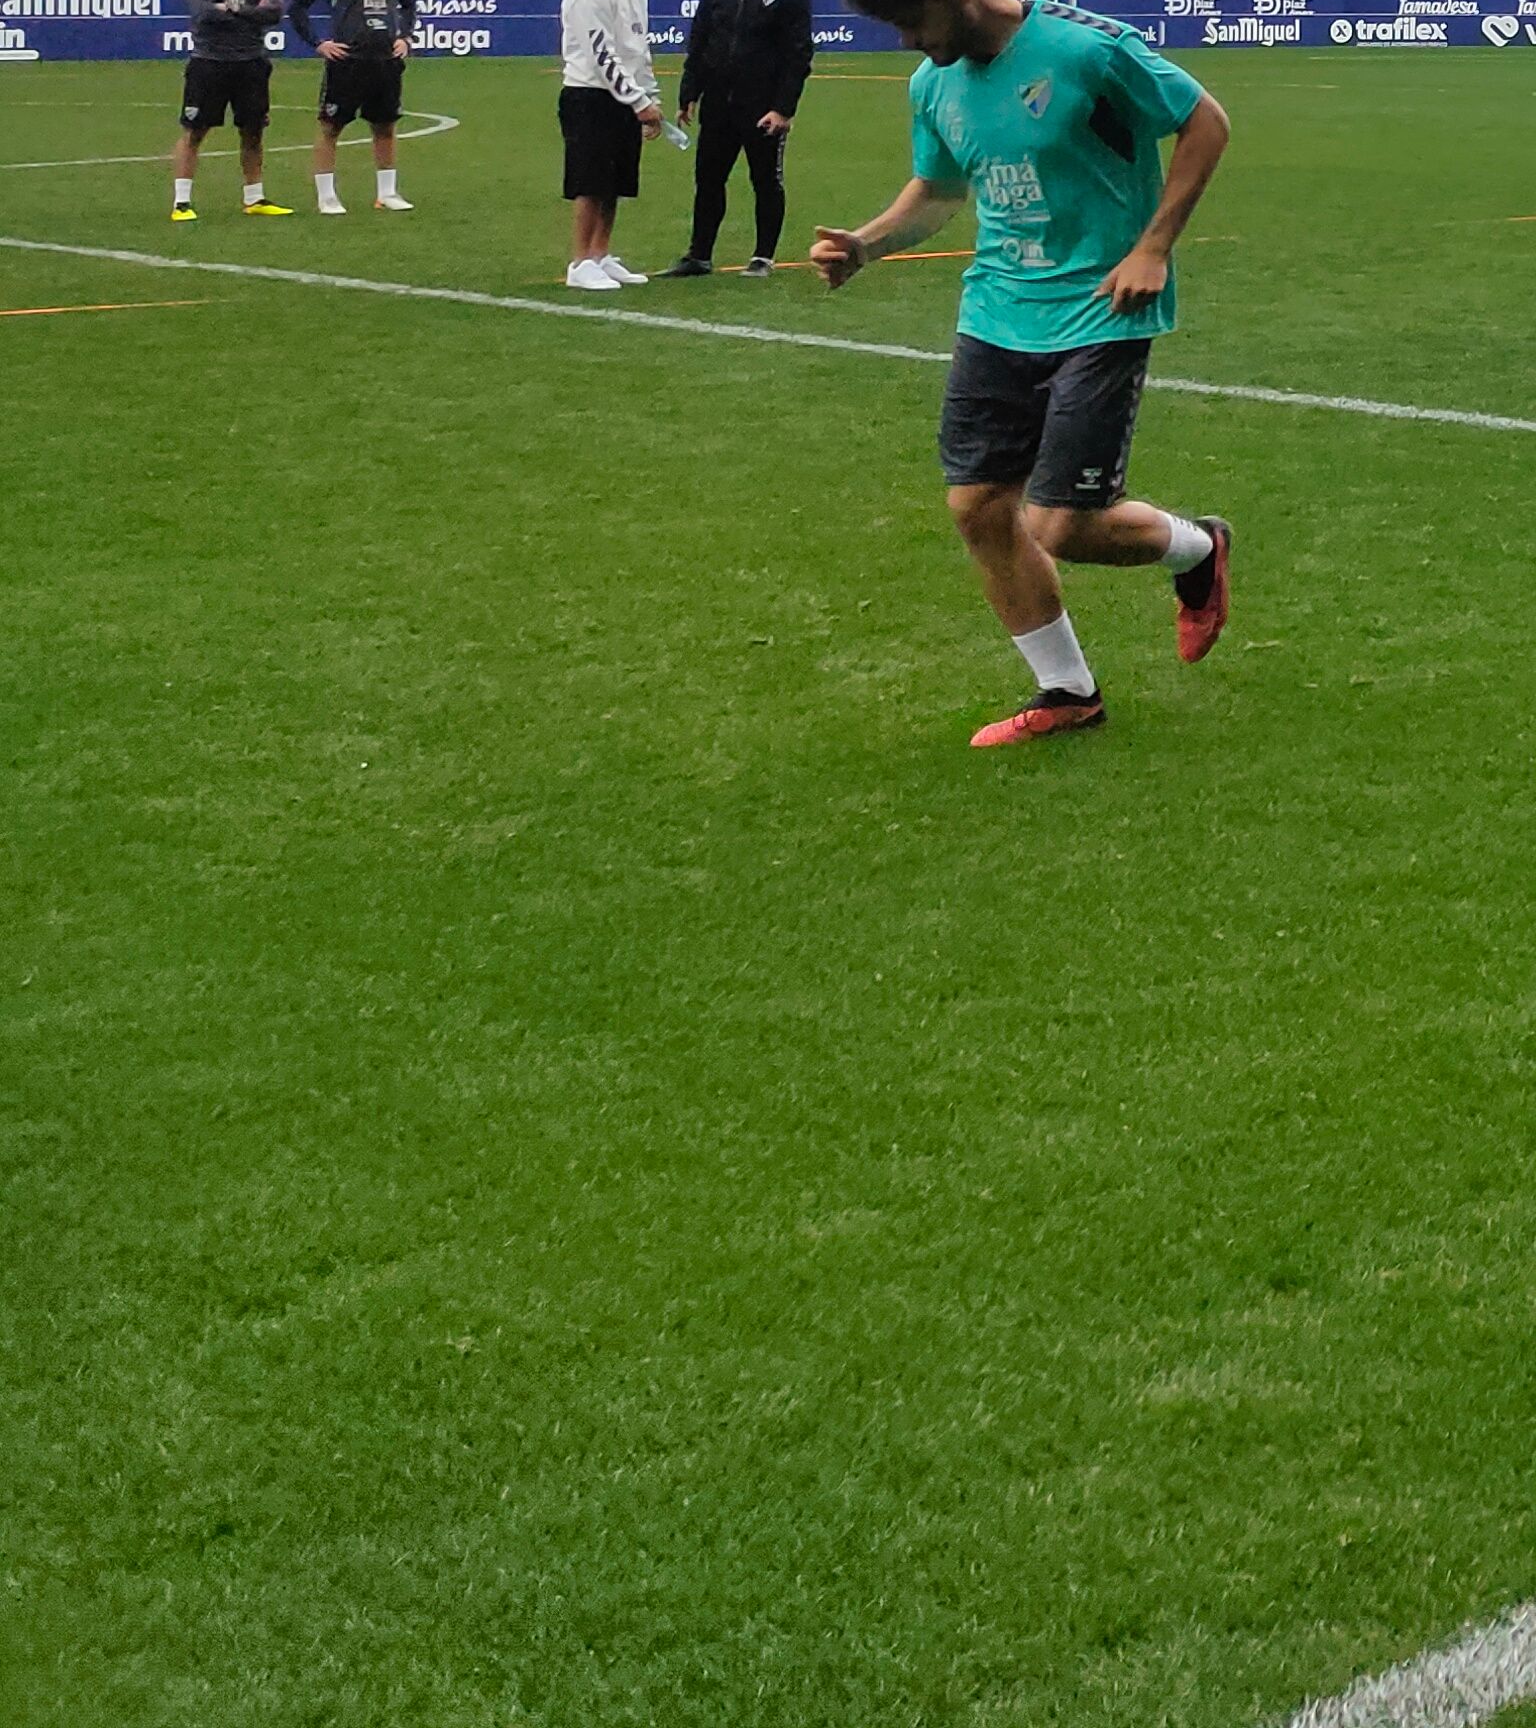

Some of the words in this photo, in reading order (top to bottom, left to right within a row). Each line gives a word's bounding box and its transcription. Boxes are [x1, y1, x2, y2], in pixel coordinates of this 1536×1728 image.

[411, 20, 491, 55] álaga
[1202, 17, 1301, 45] SanMiguel
[1356, 18, 1448, 43] trafilex
